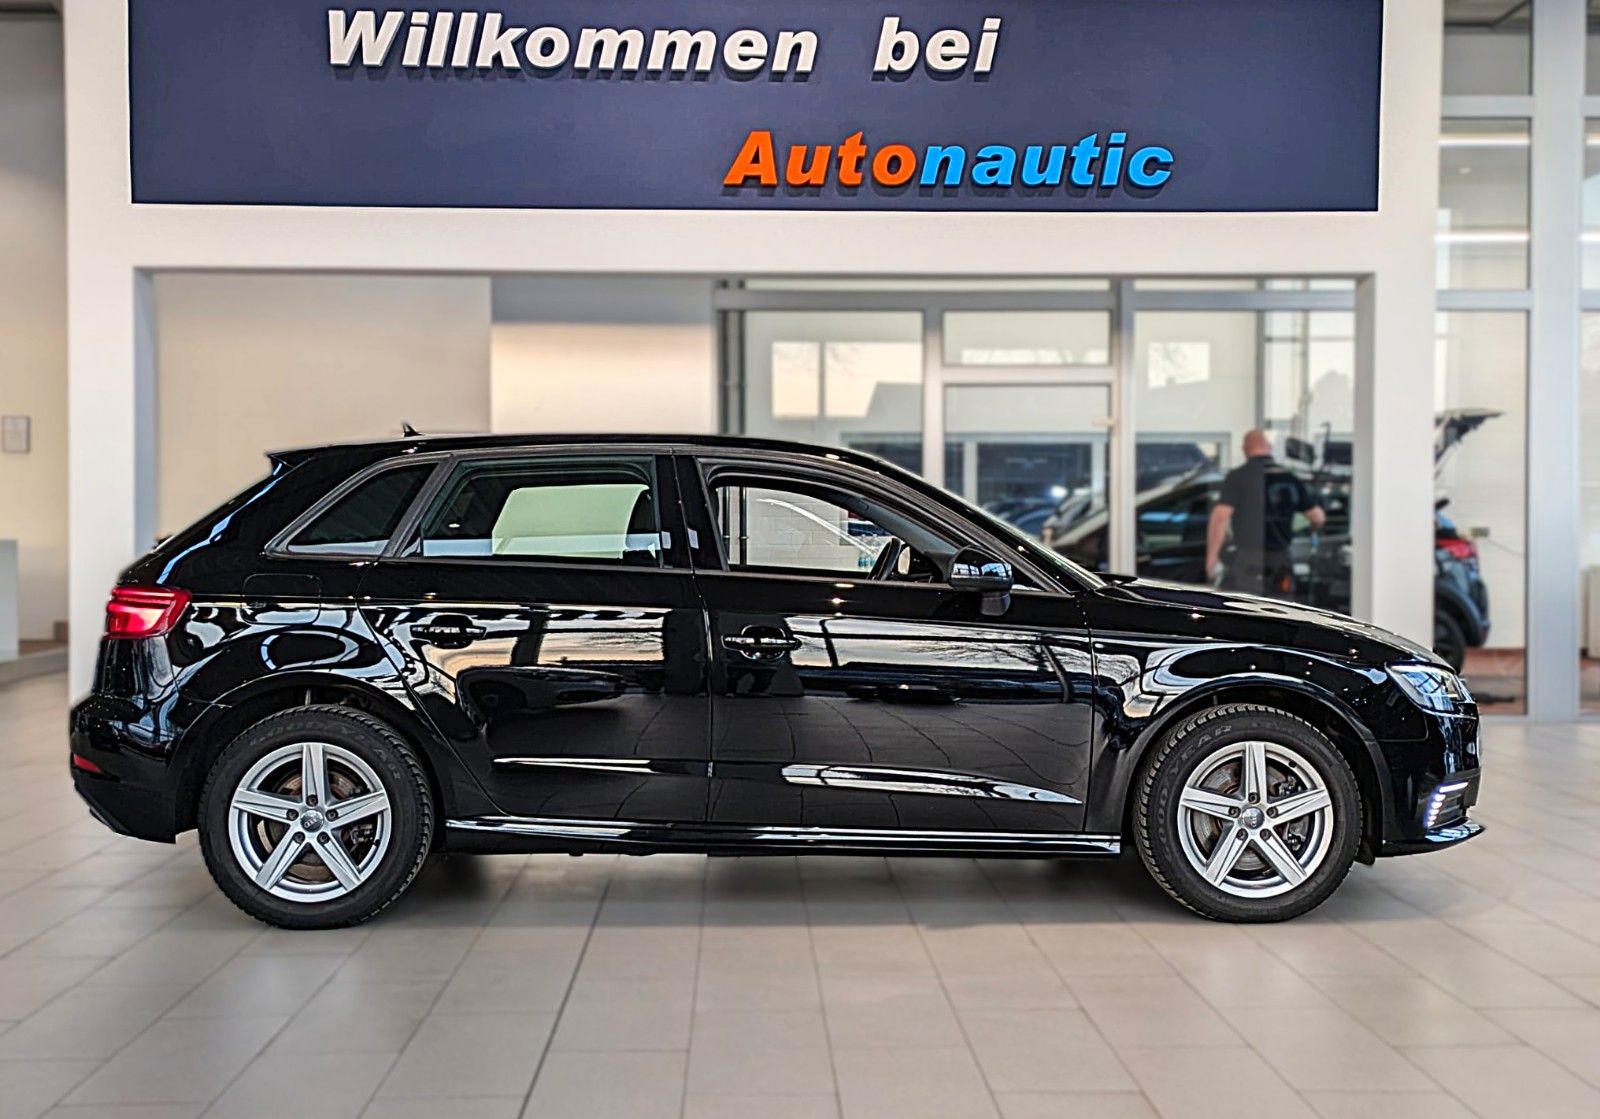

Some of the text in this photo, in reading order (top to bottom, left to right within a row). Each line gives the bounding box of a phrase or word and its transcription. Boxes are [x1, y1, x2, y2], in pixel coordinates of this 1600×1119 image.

[328, 9, 1001, 74] Willkommen bei
[723, 129, 1175, 189] Autonautic
